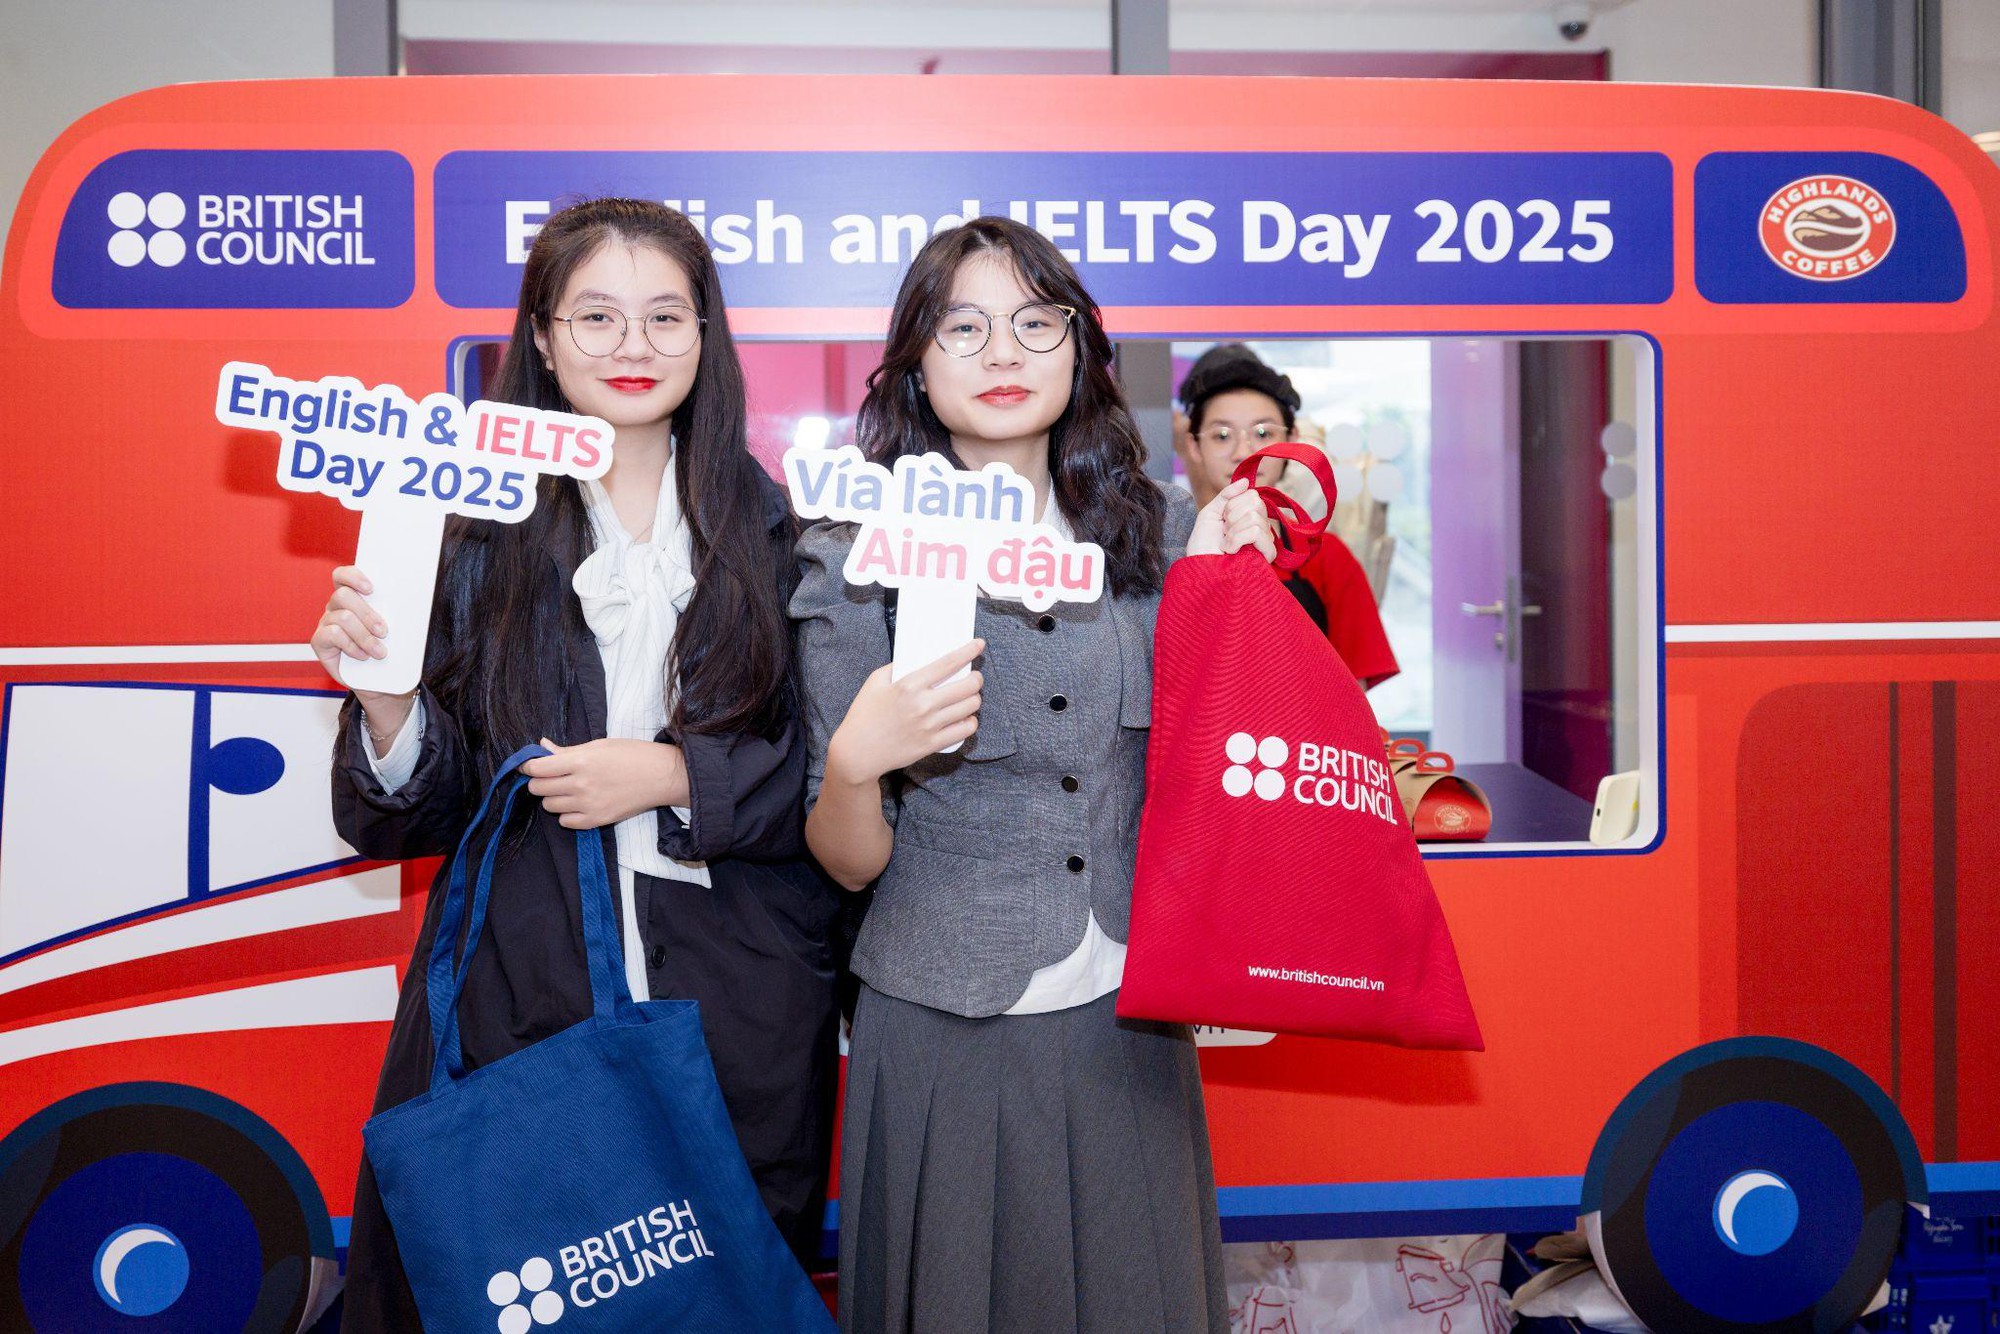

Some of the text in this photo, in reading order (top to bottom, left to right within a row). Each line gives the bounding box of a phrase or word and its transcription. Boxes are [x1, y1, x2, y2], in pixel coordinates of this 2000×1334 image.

[198, 195, 363, 229] BRITISH
[1767, 181, 1888, 224] HIGHLANDS
[195, 230, 375, 266] COUNCIL
[505, 200, 803, 264] Eish
[1242, 200, 1391, 279] Day
[1413, 199, 1615, 264] 2025
[1782, 248, 1875, 275] COFFEE
[228, 374, 603, 468] English & IELTS
[290, 439, 526, 511] Day 2025
[795, 457, 1024, 523] Vía lành
[855, 527, 1093, 599] Aim đậu
[1299, 742, 1392, 793] BRITISH
[1293, 774, 1398, 826] COUNCIL
[1247, 965, 1386, 992] www.britishcouncil.vn
[559, 1199, 698, 1279] BRITISH
[569, 1229, 715, 1308] COUNCIL
